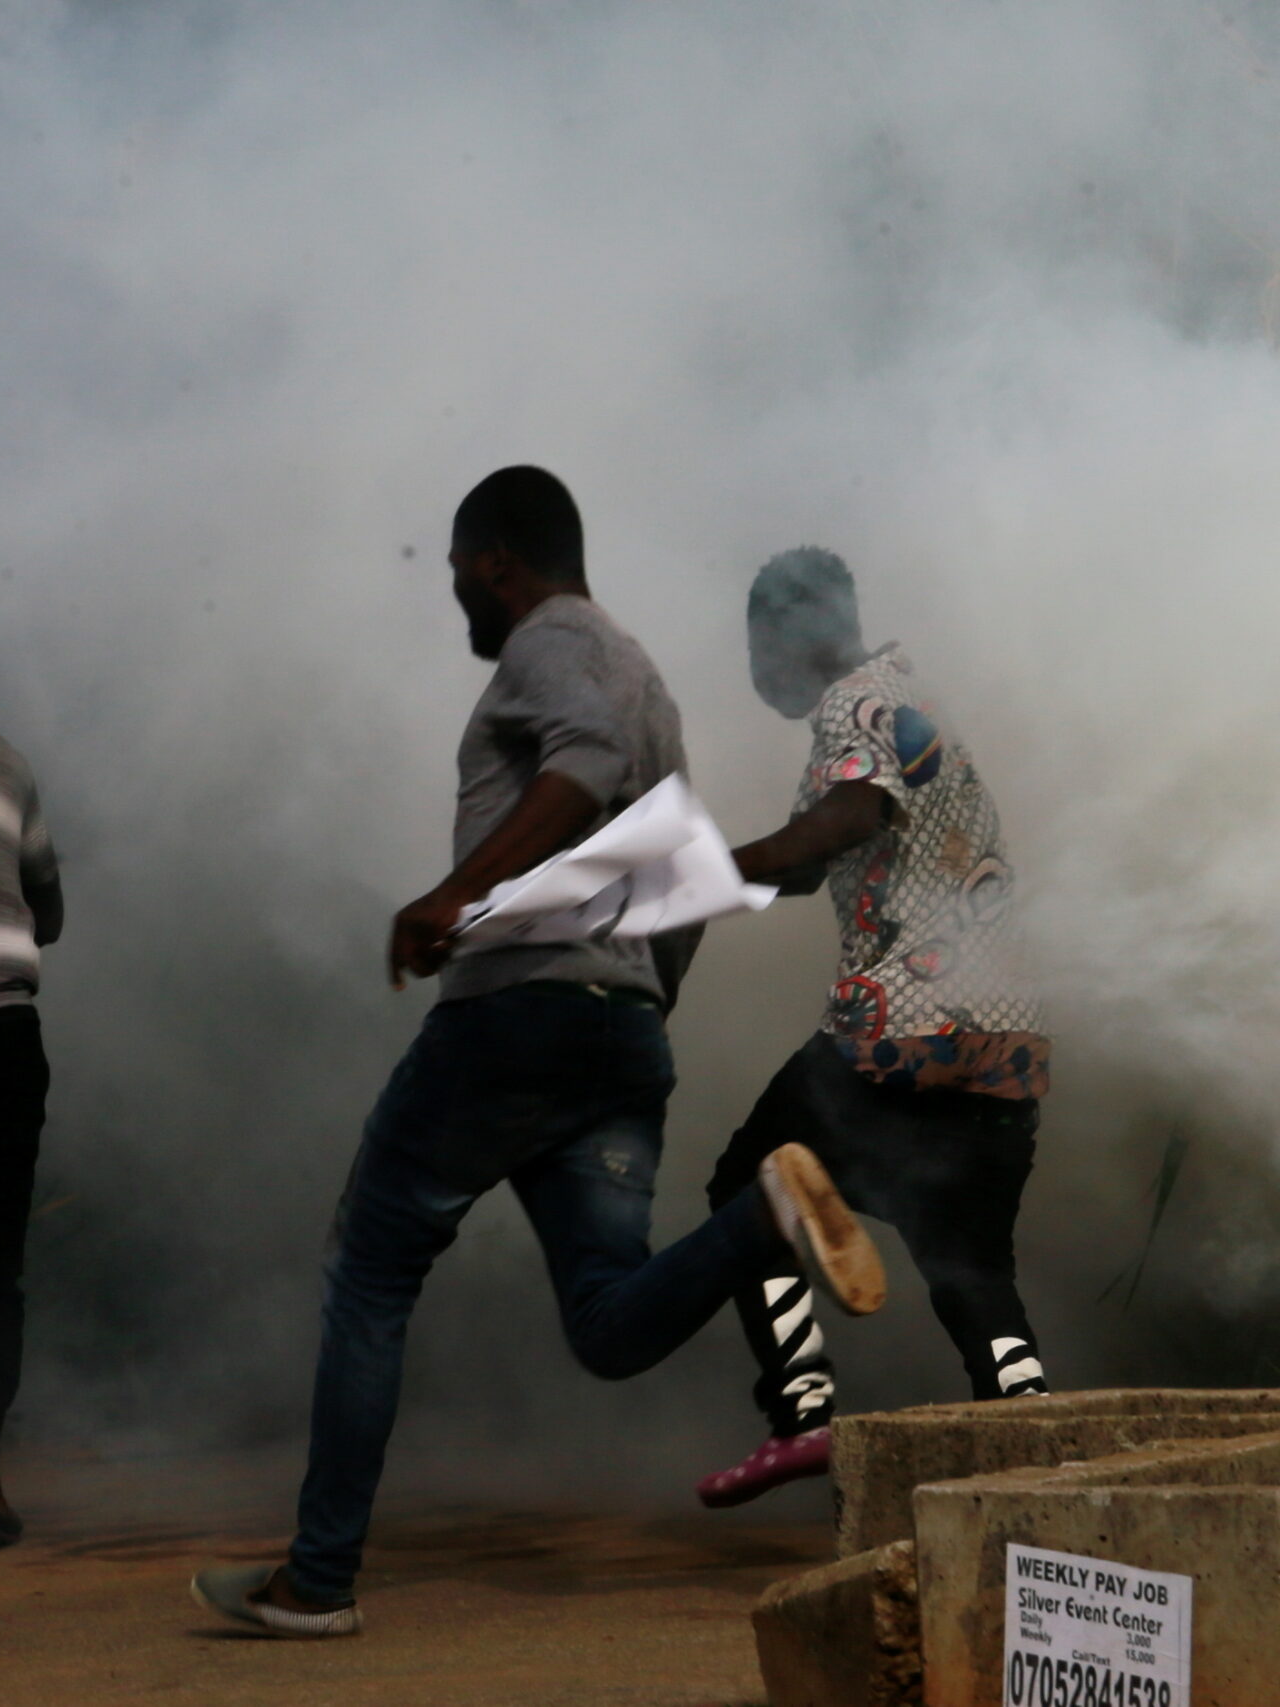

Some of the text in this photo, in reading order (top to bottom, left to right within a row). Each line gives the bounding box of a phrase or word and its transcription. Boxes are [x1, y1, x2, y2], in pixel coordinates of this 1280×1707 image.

[1017, 1555, 1168, 1605] WEEKLY PAY JOB
[1018, 1587, 1163, 1636] Silver Event Center
[1021, 1610, 1042, 1629] Daily
[1020, 1627, 1052, 1646] Weekly
